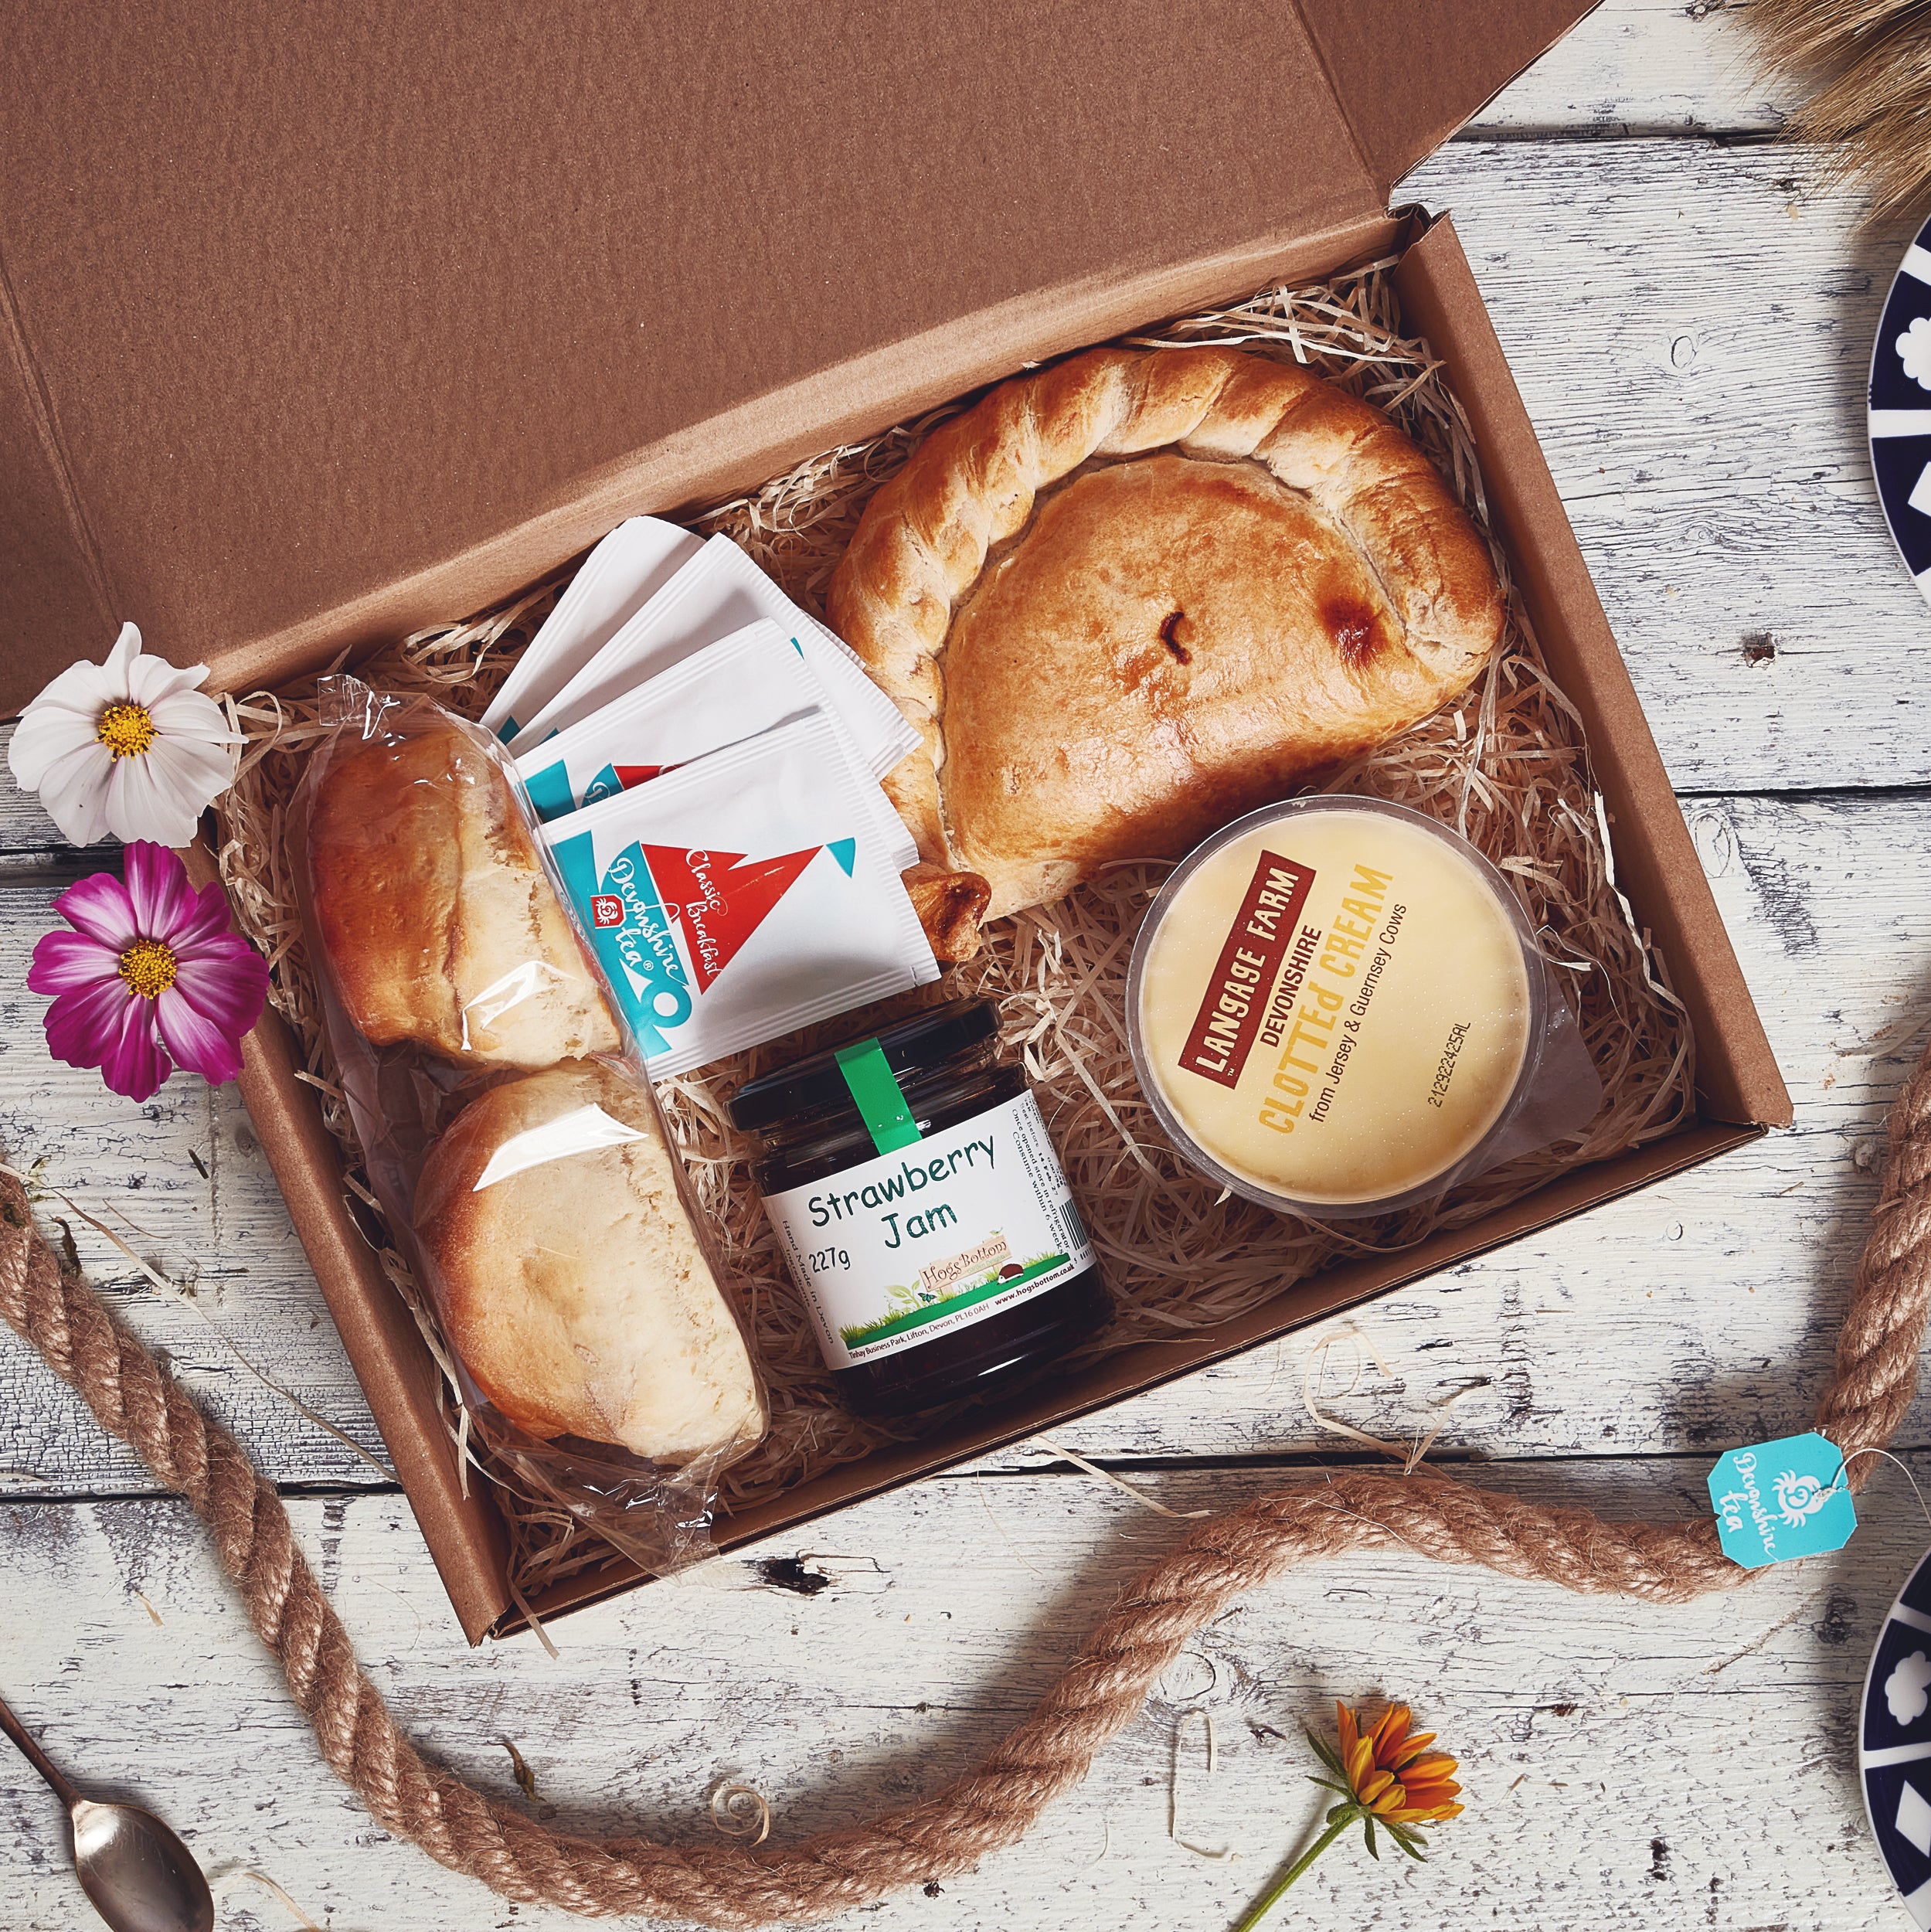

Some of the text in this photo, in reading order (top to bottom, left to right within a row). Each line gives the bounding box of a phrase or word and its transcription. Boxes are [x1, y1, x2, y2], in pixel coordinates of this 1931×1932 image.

[607, 857, 689, 986] Devonshire
[685, 849, 728, 916] Classic
[1246, 867, 1299, 941] FARM
[1319, 863, 1394, 979] CREAM
[685, 901, 723, 979] Breakfast
[1260, 925, 1322, 1048] DEVONSHIRE
[1309, 903, 1407, 1123] from Jersey & Guernsey Cows
[1427, 1022, 1471, 1108] 212922425AL
[808, 1135, 994, 1227] Strawberry
[1011, 1108, 1023, 1131] Once
[1022, 1133, 1038, 1165] opened
[1034, 1165, 1045, 1187] store
[1043, 1189, 1050, 1198] in
[1047, 1199, 1070, 1249] refrigerator
[1012, 1131, 1034, 1179] Consume
[1032, 1180, 1048, 1212] within
[1049, 1223, 1064, 1254] weeks
[808, 1247, 851, 1274] 227g
[881, 1204, 958, 1249] Jam
[783, 1220, 835, 1344] Hand Made in Devon
[994, 1264, 1076, 1306] www.hogsbottom.co.uk
[848, 1349, 865, 1360] Tinhay
[865, 1342, 891, 1355] Business
[890, 1336, 907, 1346] Park,
[906, 1328, 930, 1341] Lifton,
[929, 1318, 956, 1332] Devon,
[1719, 1490, 1749, 1533] tea
[1732, 1452, 1779, 1562] Devonshire
